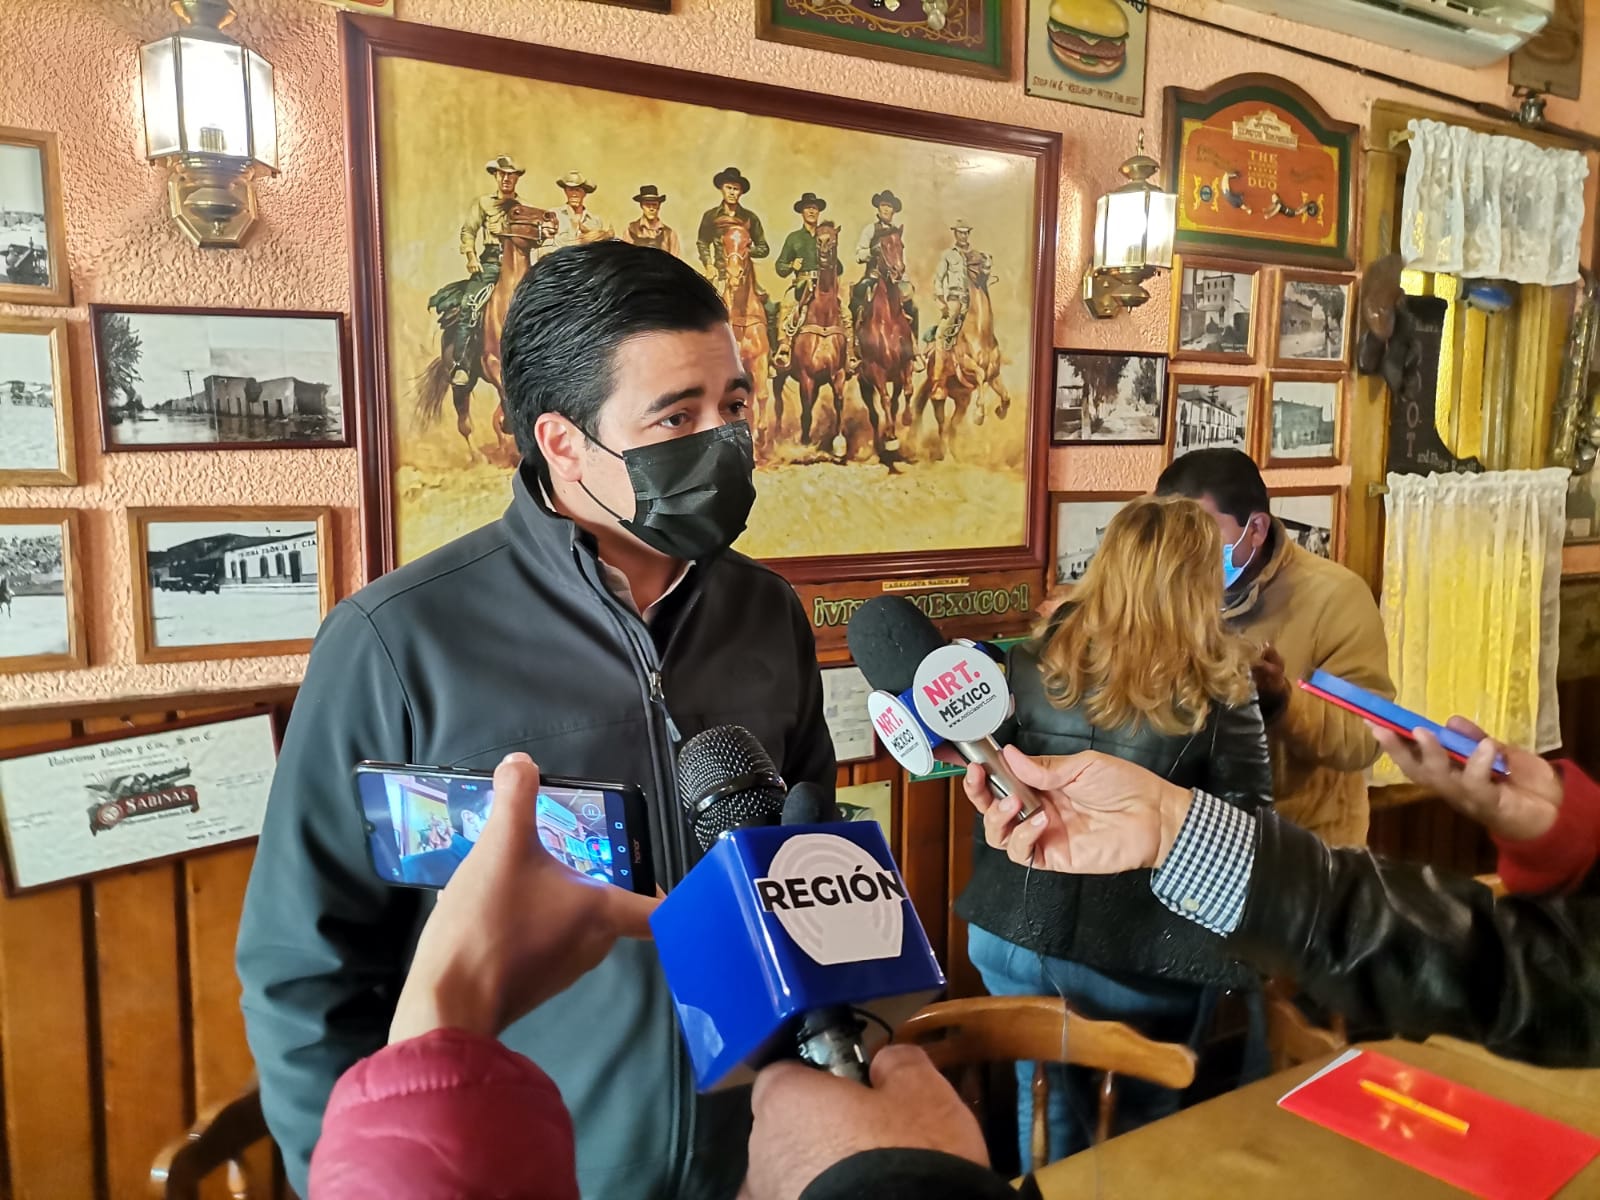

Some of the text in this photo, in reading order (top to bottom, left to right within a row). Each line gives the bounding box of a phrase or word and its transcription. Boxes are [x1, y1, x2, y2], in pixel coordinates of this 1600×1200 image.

[1248, 149, 1278, 163] THE
[1248, 177, 1277, 191] DUO
[922, 659, 981, 706] NRT.
[938, 681, 991, 722] MÉXICO
[876, 706, 904, 737] NRT.
[124, 788, 191, 813] SABINAS
[756, 865, 908, 912] REGIÓN
